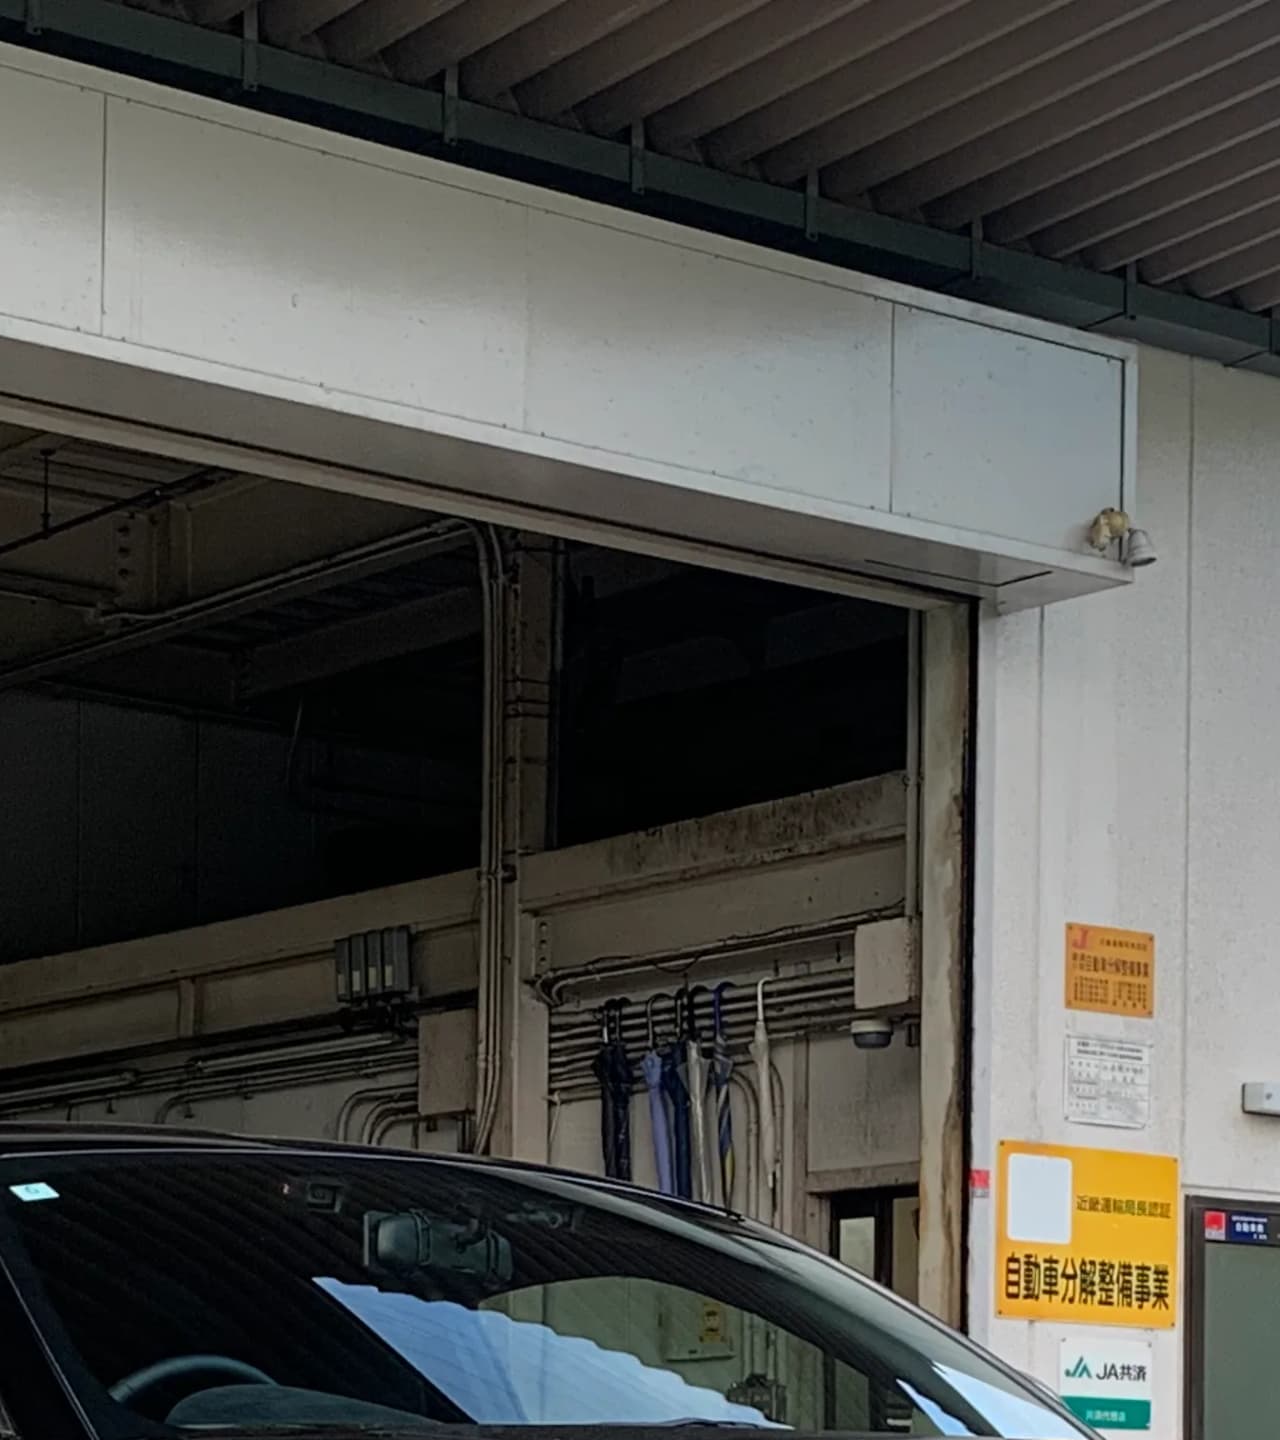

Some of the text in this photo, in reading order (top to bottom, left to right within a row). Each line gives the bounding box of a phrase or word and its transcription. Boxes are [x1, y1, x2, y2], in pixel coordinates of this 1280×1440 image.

[1005, 1252, 1169, 1310] 自動車分解整備事業
[1096, 1363, 1147, 1382] JA共済
